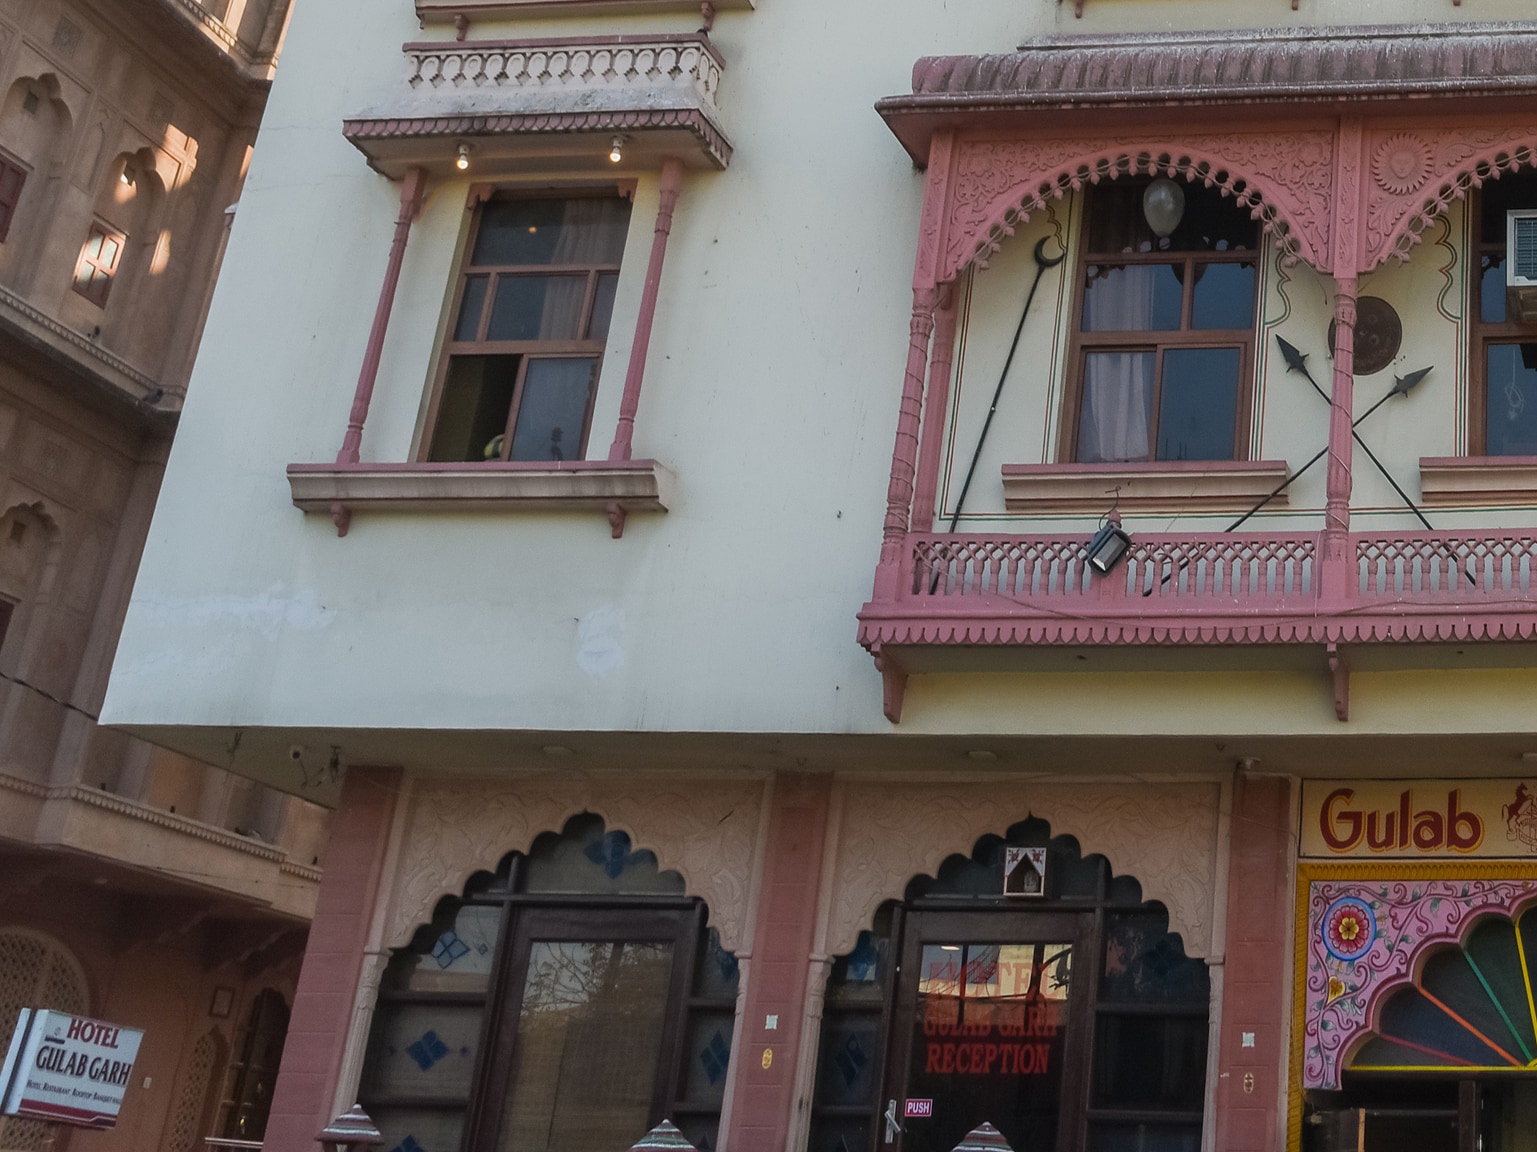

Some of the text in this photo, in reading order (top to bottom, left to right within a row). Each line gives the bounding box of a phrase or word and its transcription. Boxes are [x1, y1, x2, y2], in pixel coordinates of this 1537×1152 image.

[1319, 788, 1485, 853] Gulab
[67, 1018, 120, 1049] HOTEL
[36, 1046, 132, 1086] GULAB GARH
[925, 1043, 1051, 1074] RECEPTION
[907, 1102, 930, 1113] PUSH
